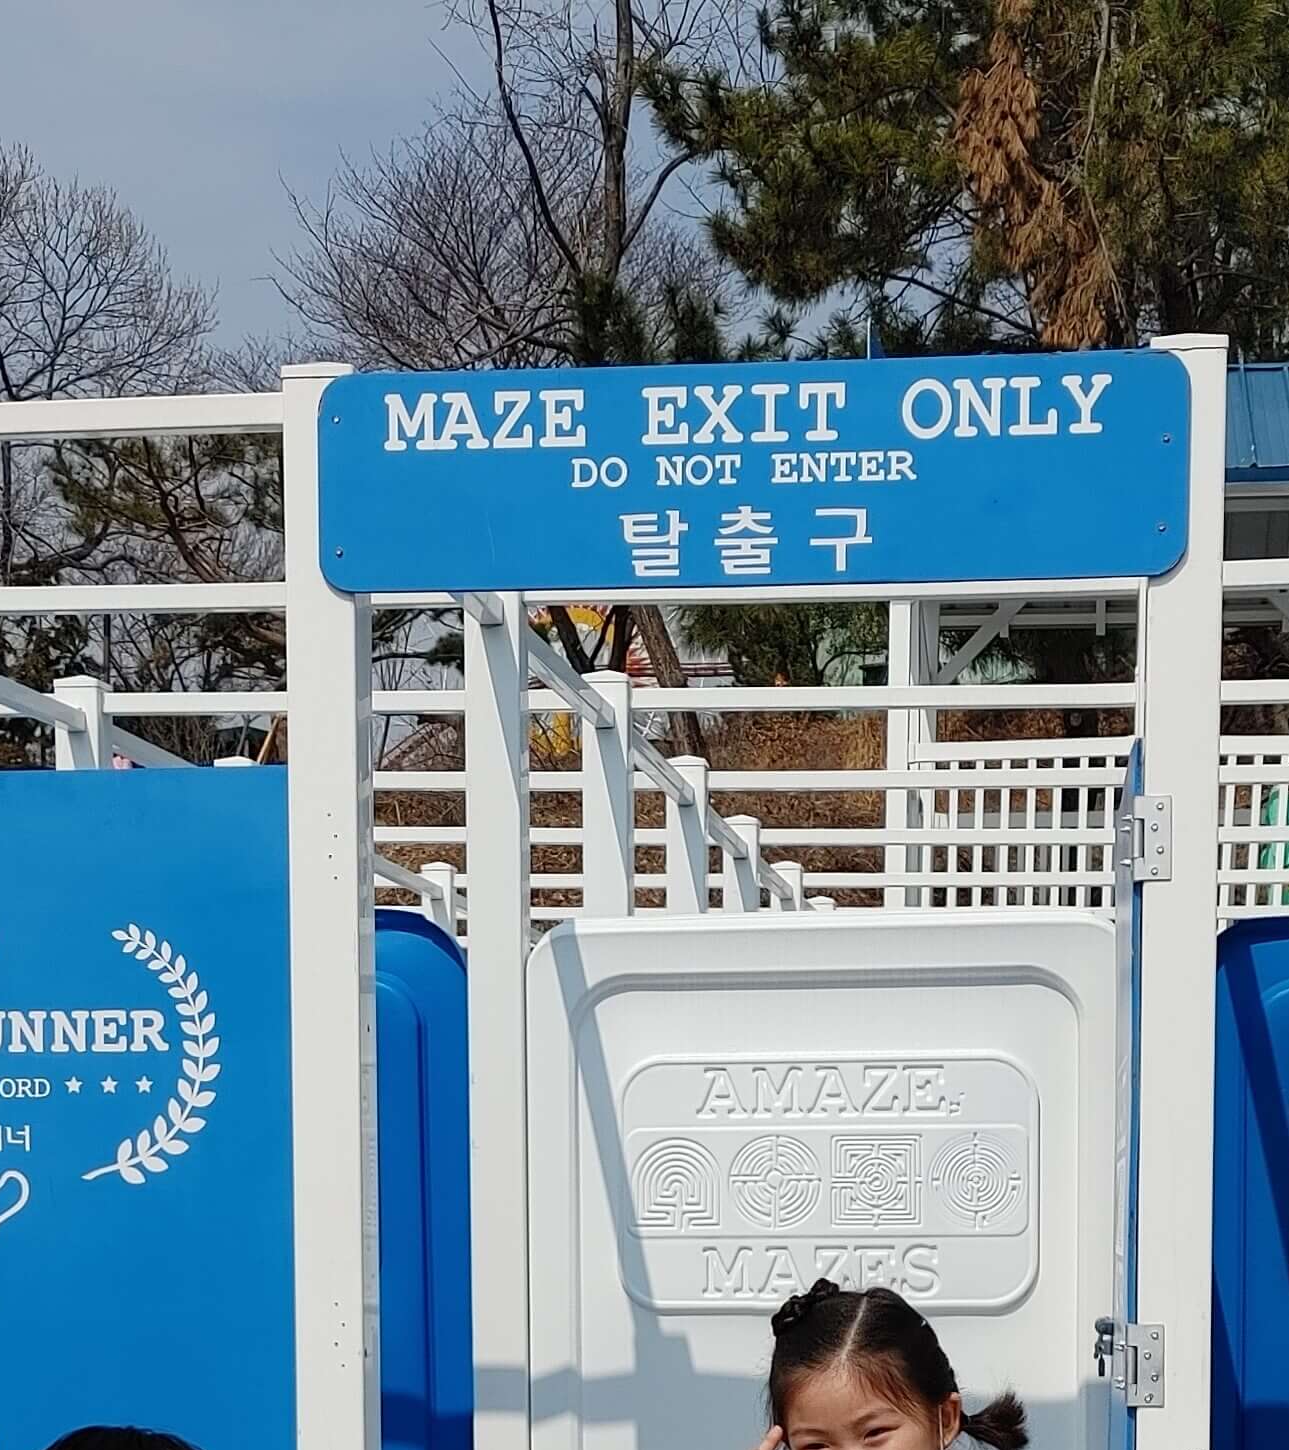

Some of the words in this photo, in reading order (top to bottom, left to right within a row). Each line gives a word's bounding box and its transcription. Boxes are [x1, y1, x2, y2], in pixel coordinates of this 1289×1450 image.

[384, 389, 586, 451] MAZE
[641, 382, 846, 446] EXIT
[901, 373, 1113, 440] ONLY
[571, 456, 628, 488] DO
[655, 454, 741, 486] NOT
[771, 450, 917, 484] ENTER
[618, 505, 873, 577] 탈출구
